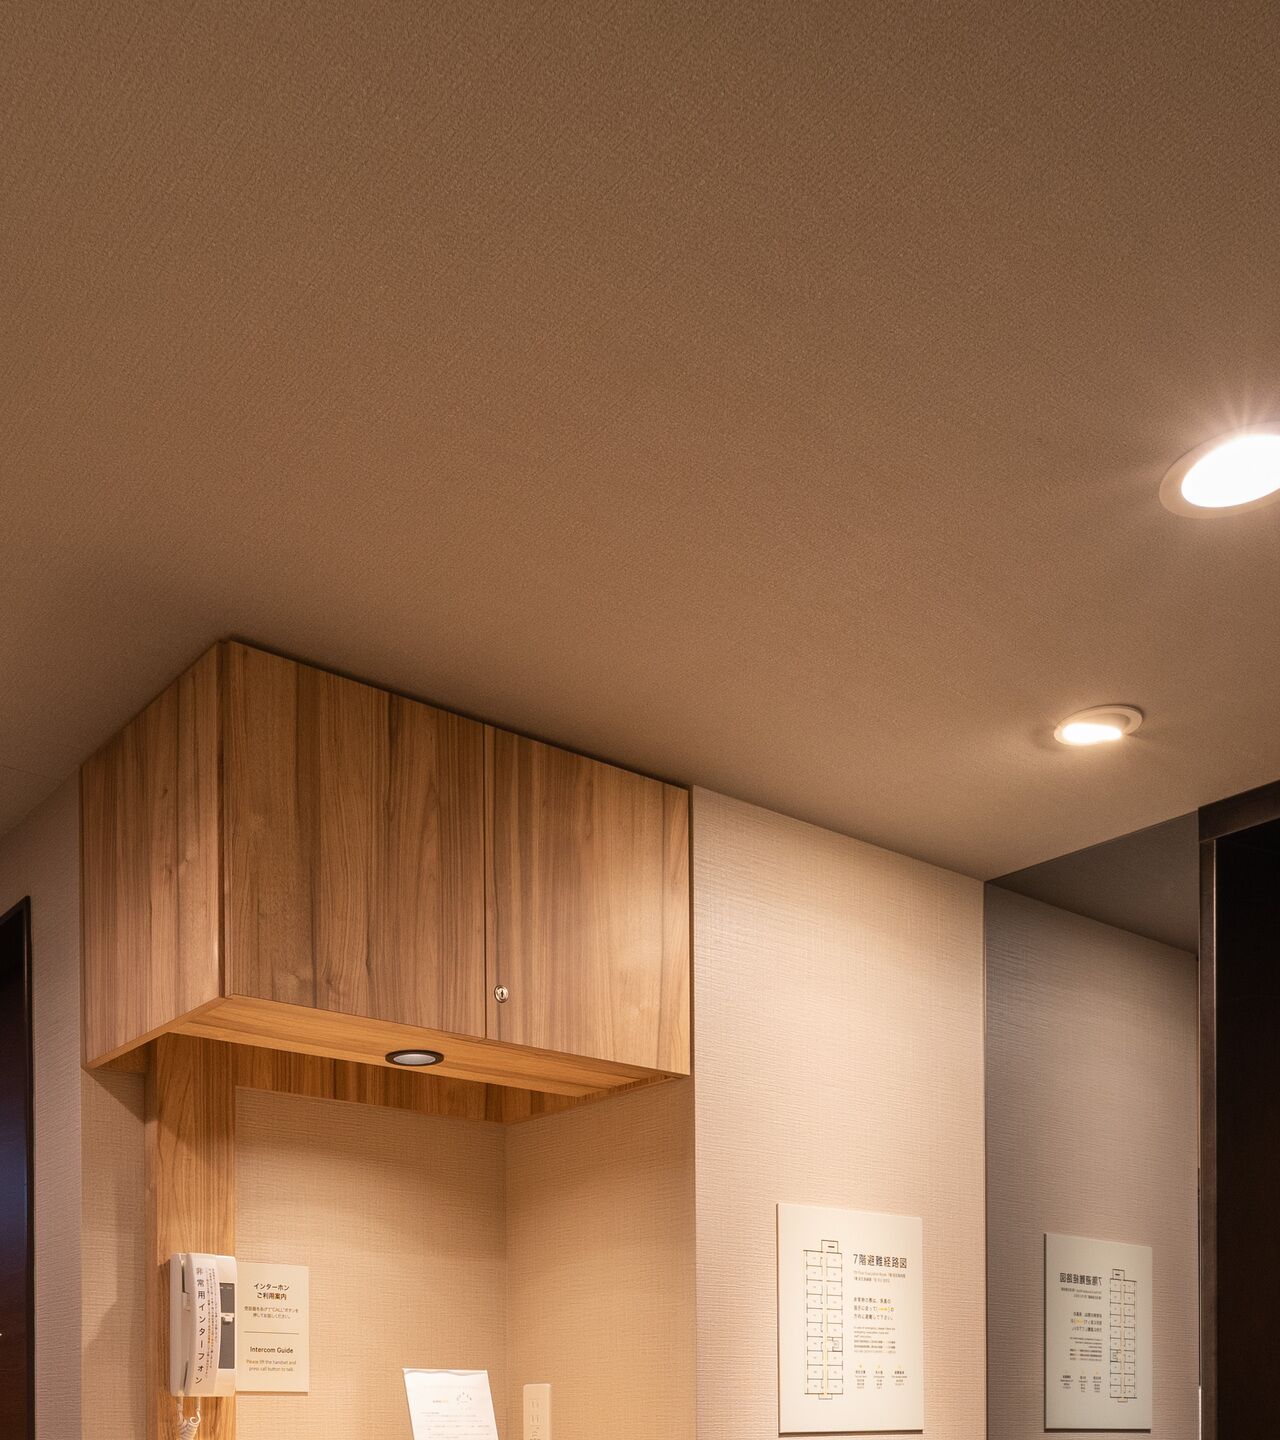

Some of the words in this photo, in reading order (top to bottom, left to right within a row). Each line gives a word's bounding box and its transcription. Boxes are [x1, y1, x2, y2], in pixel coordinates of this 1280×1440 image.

[253, 1283, 290, 1292] インターホン
[256, 1292, 287, 1300] ご利用案内
[195, 1267, 206, 1385] 非常用インターフォン
